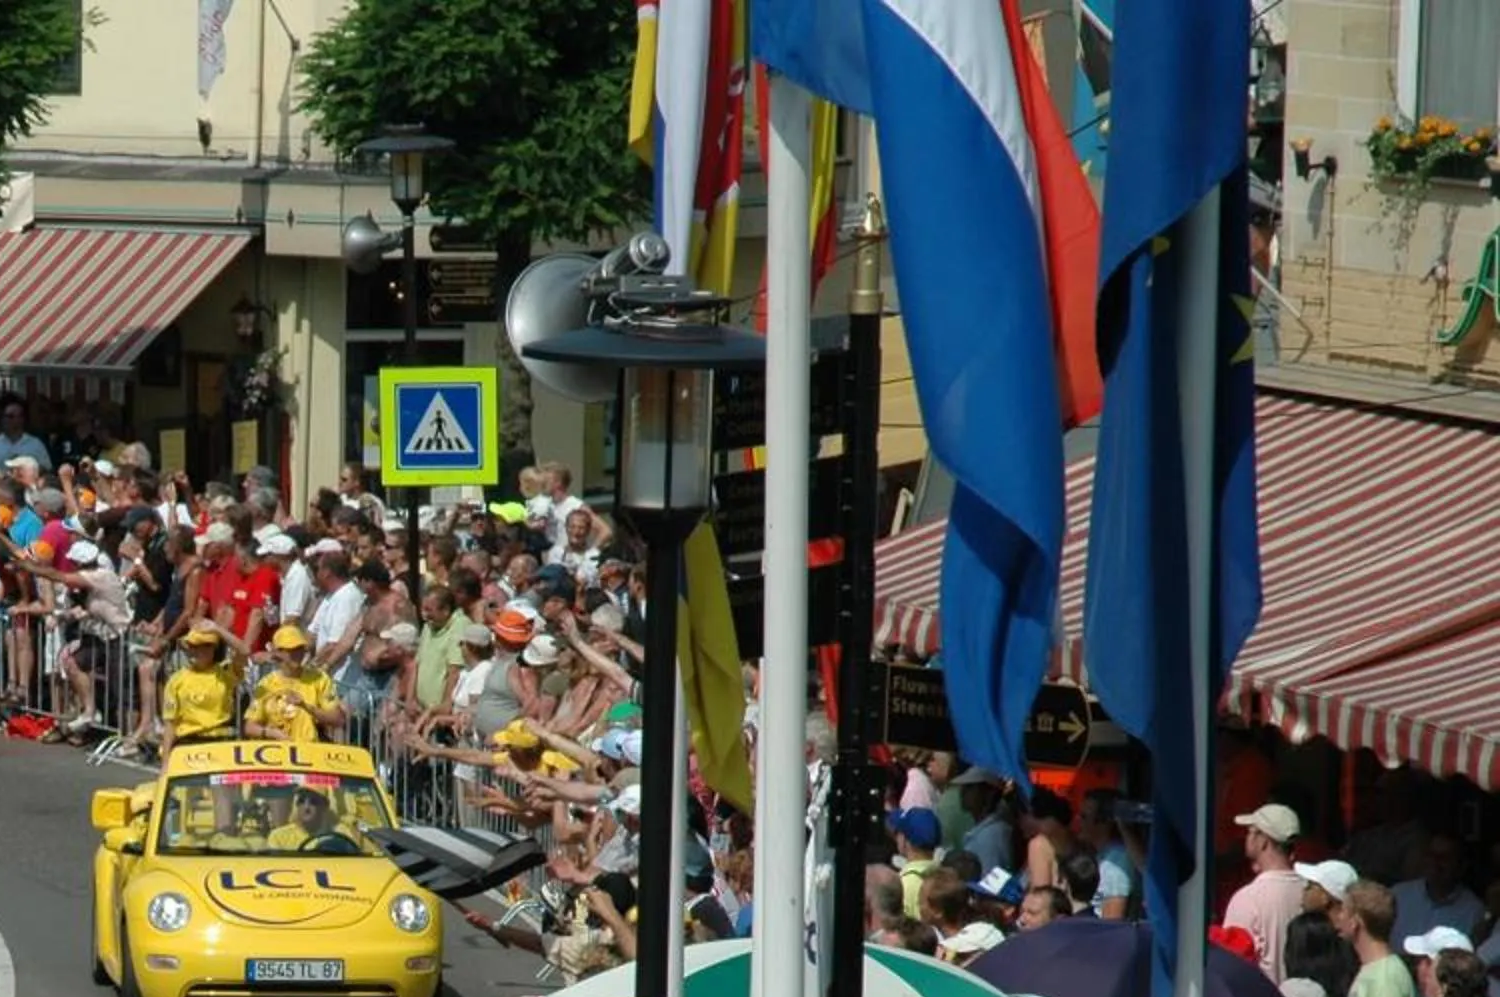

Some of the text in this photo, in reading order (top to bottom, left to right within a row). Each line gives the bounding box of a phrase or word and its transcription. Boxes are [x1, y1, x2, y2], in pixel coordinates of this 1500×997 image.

[233, 745, 314, 767] LCL
[220, 869, 357, 892] LCL
[256, 962, 342, 979] 9545 TL 87
